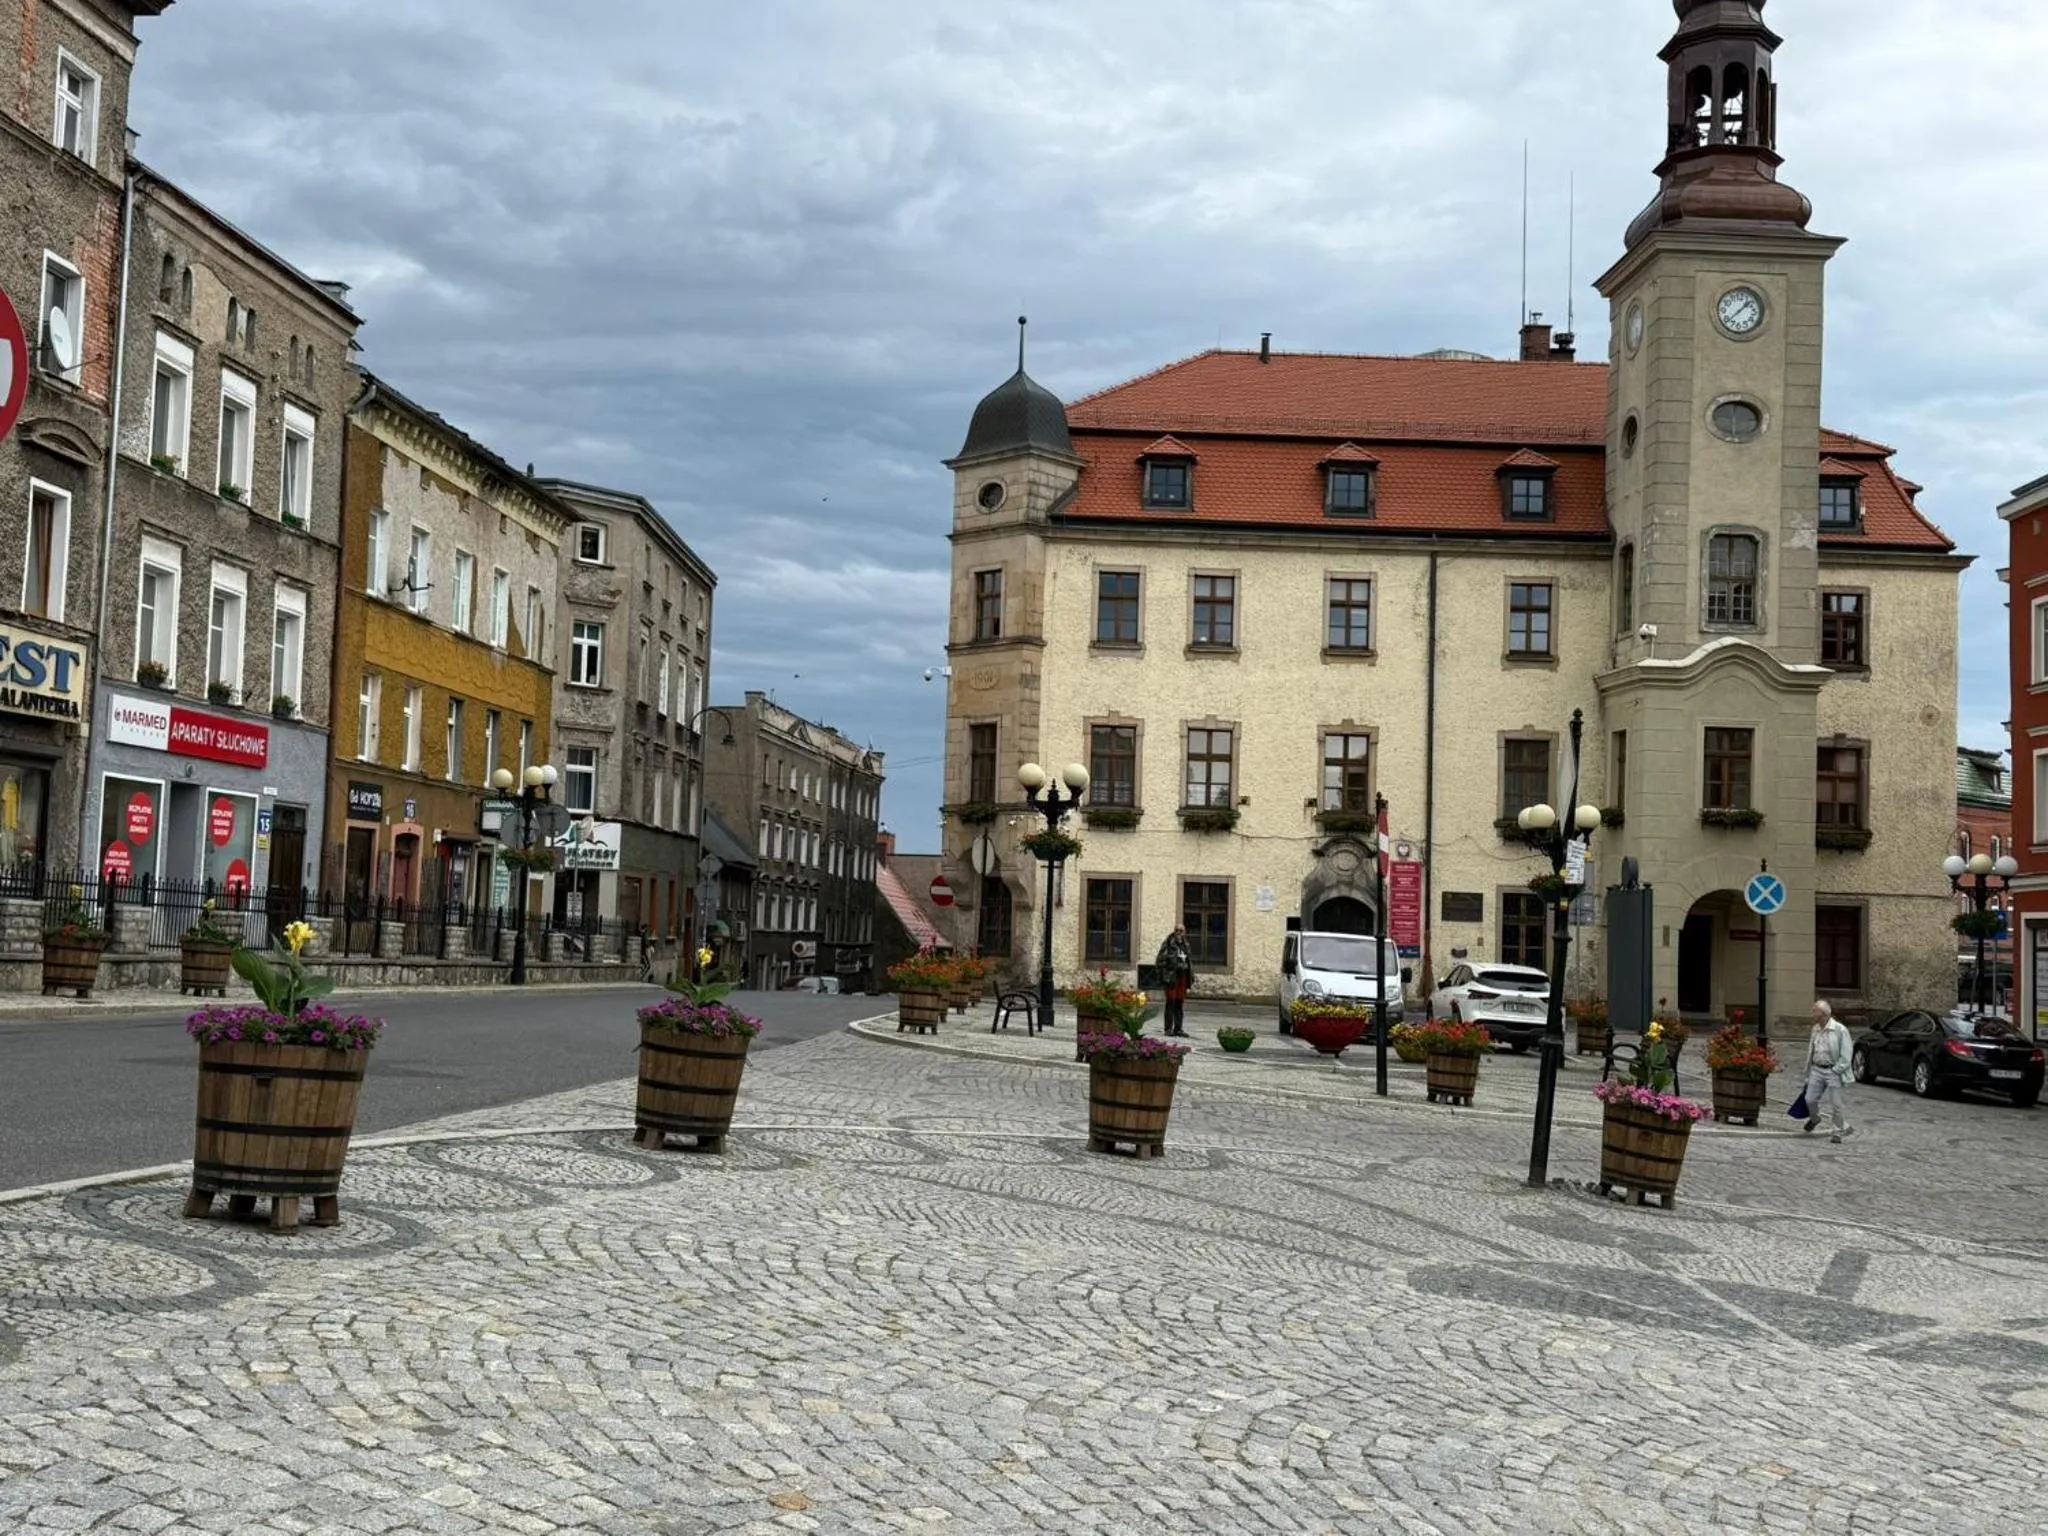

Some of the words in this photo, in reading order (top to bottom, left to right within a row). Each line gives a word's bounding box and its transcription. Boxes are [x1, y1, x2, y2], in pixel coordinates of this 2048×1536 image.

[122, 709, 167, 730] MARMED
[171, 722, 215, 747] APARATY
[216, 730, 265, 756] SŁUCHOWE
[260, 818, 269, 832] 15
